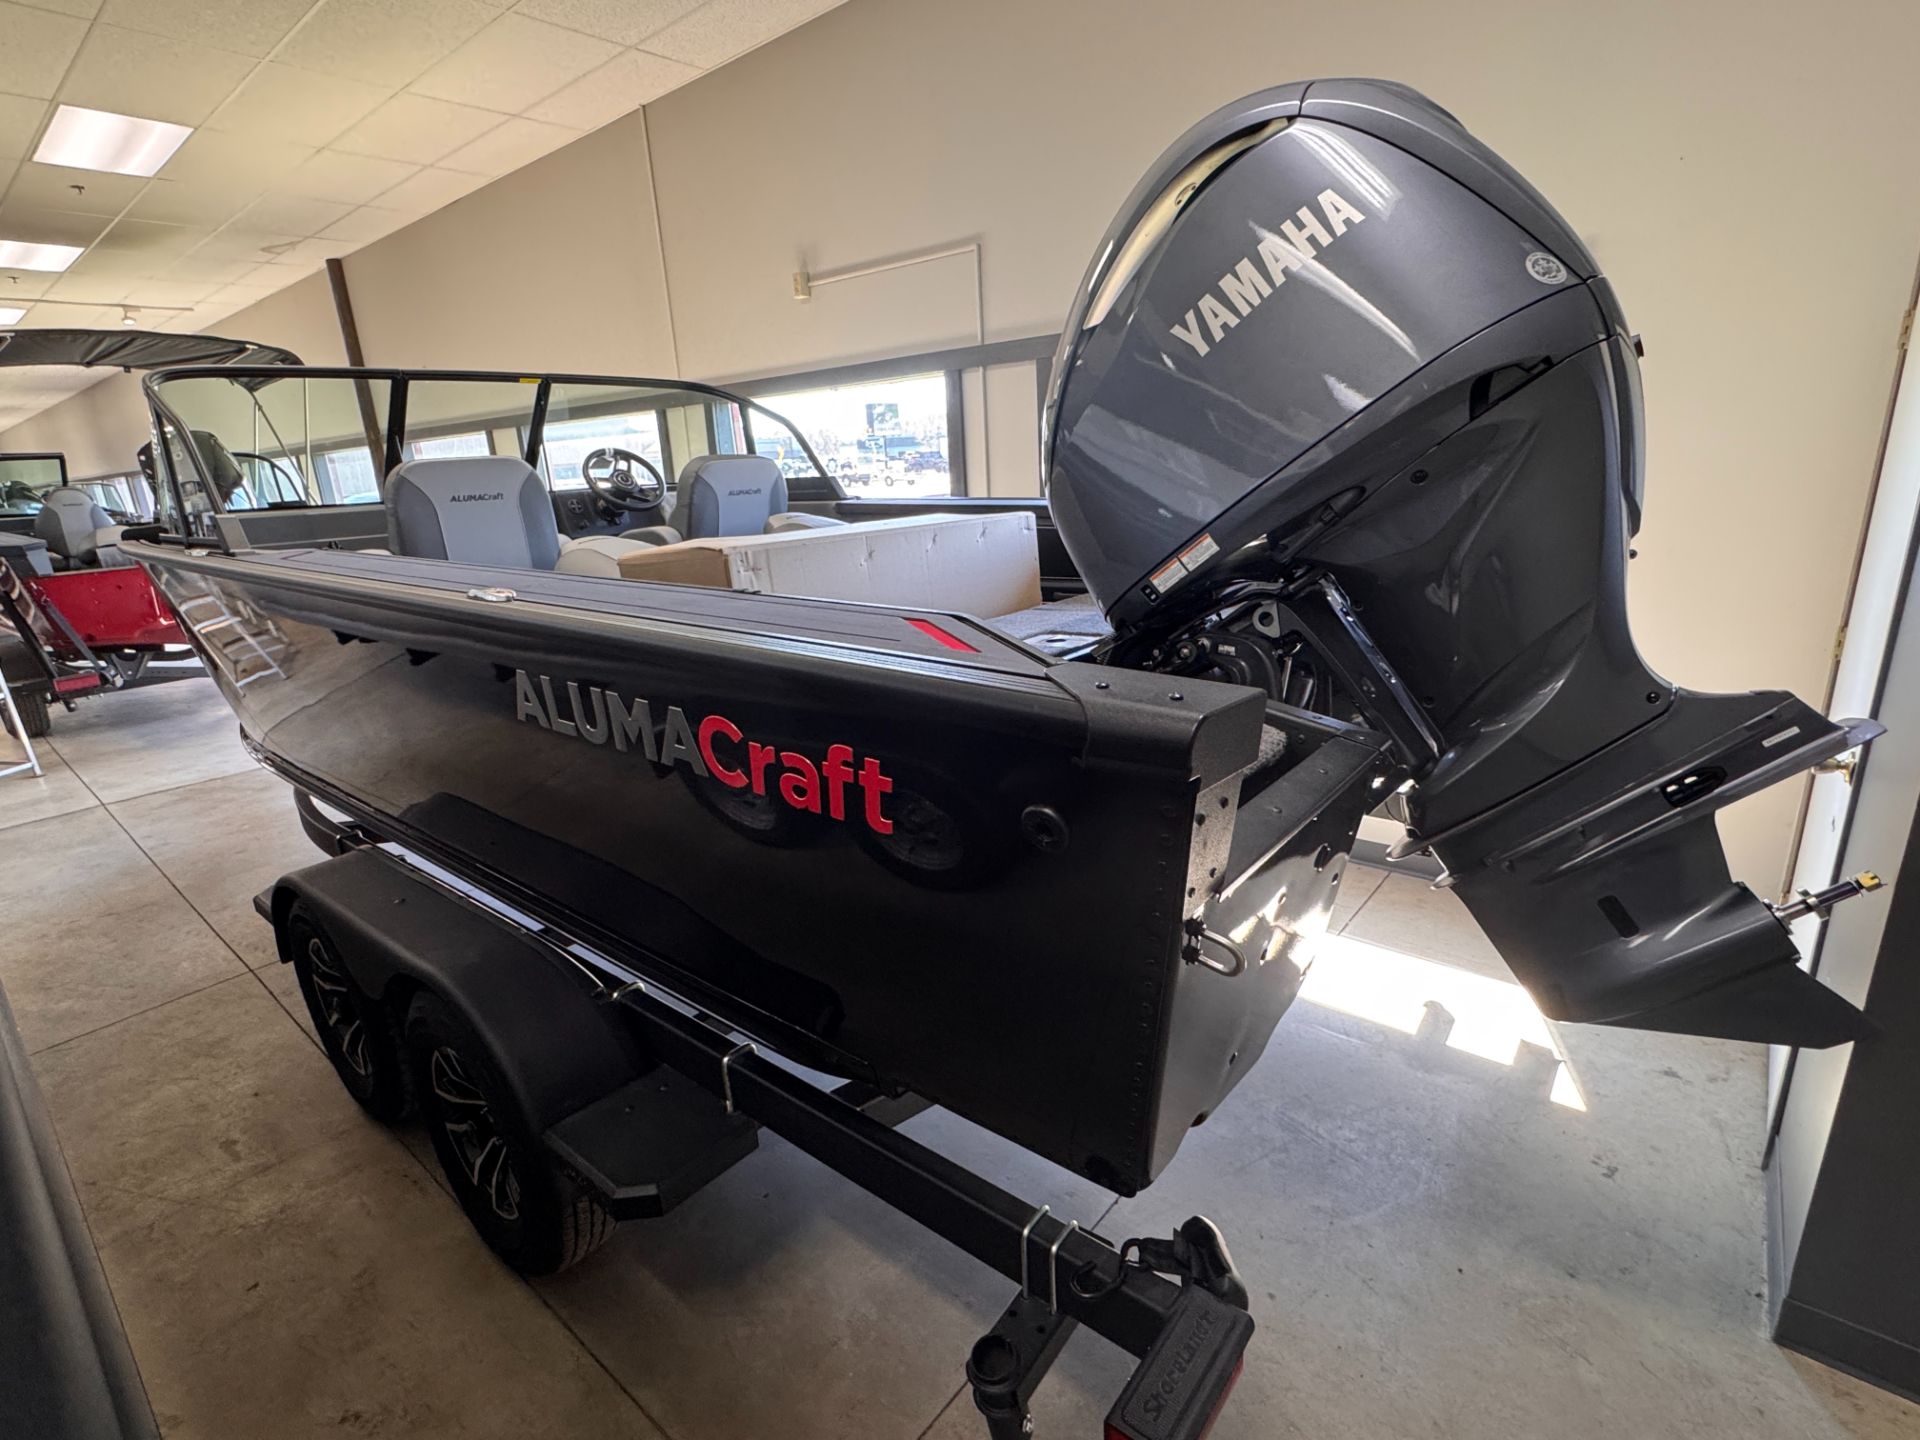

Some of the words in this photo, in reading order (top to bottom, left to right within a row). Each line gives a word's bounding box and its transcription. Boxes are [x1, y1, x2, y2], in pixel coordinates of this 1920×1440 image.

[1169, 188, 1366, 358] YAMAHA
[450, 492, 504, 502] ALUMACraft
[515, 669, 893, 835] ALUMACraft
